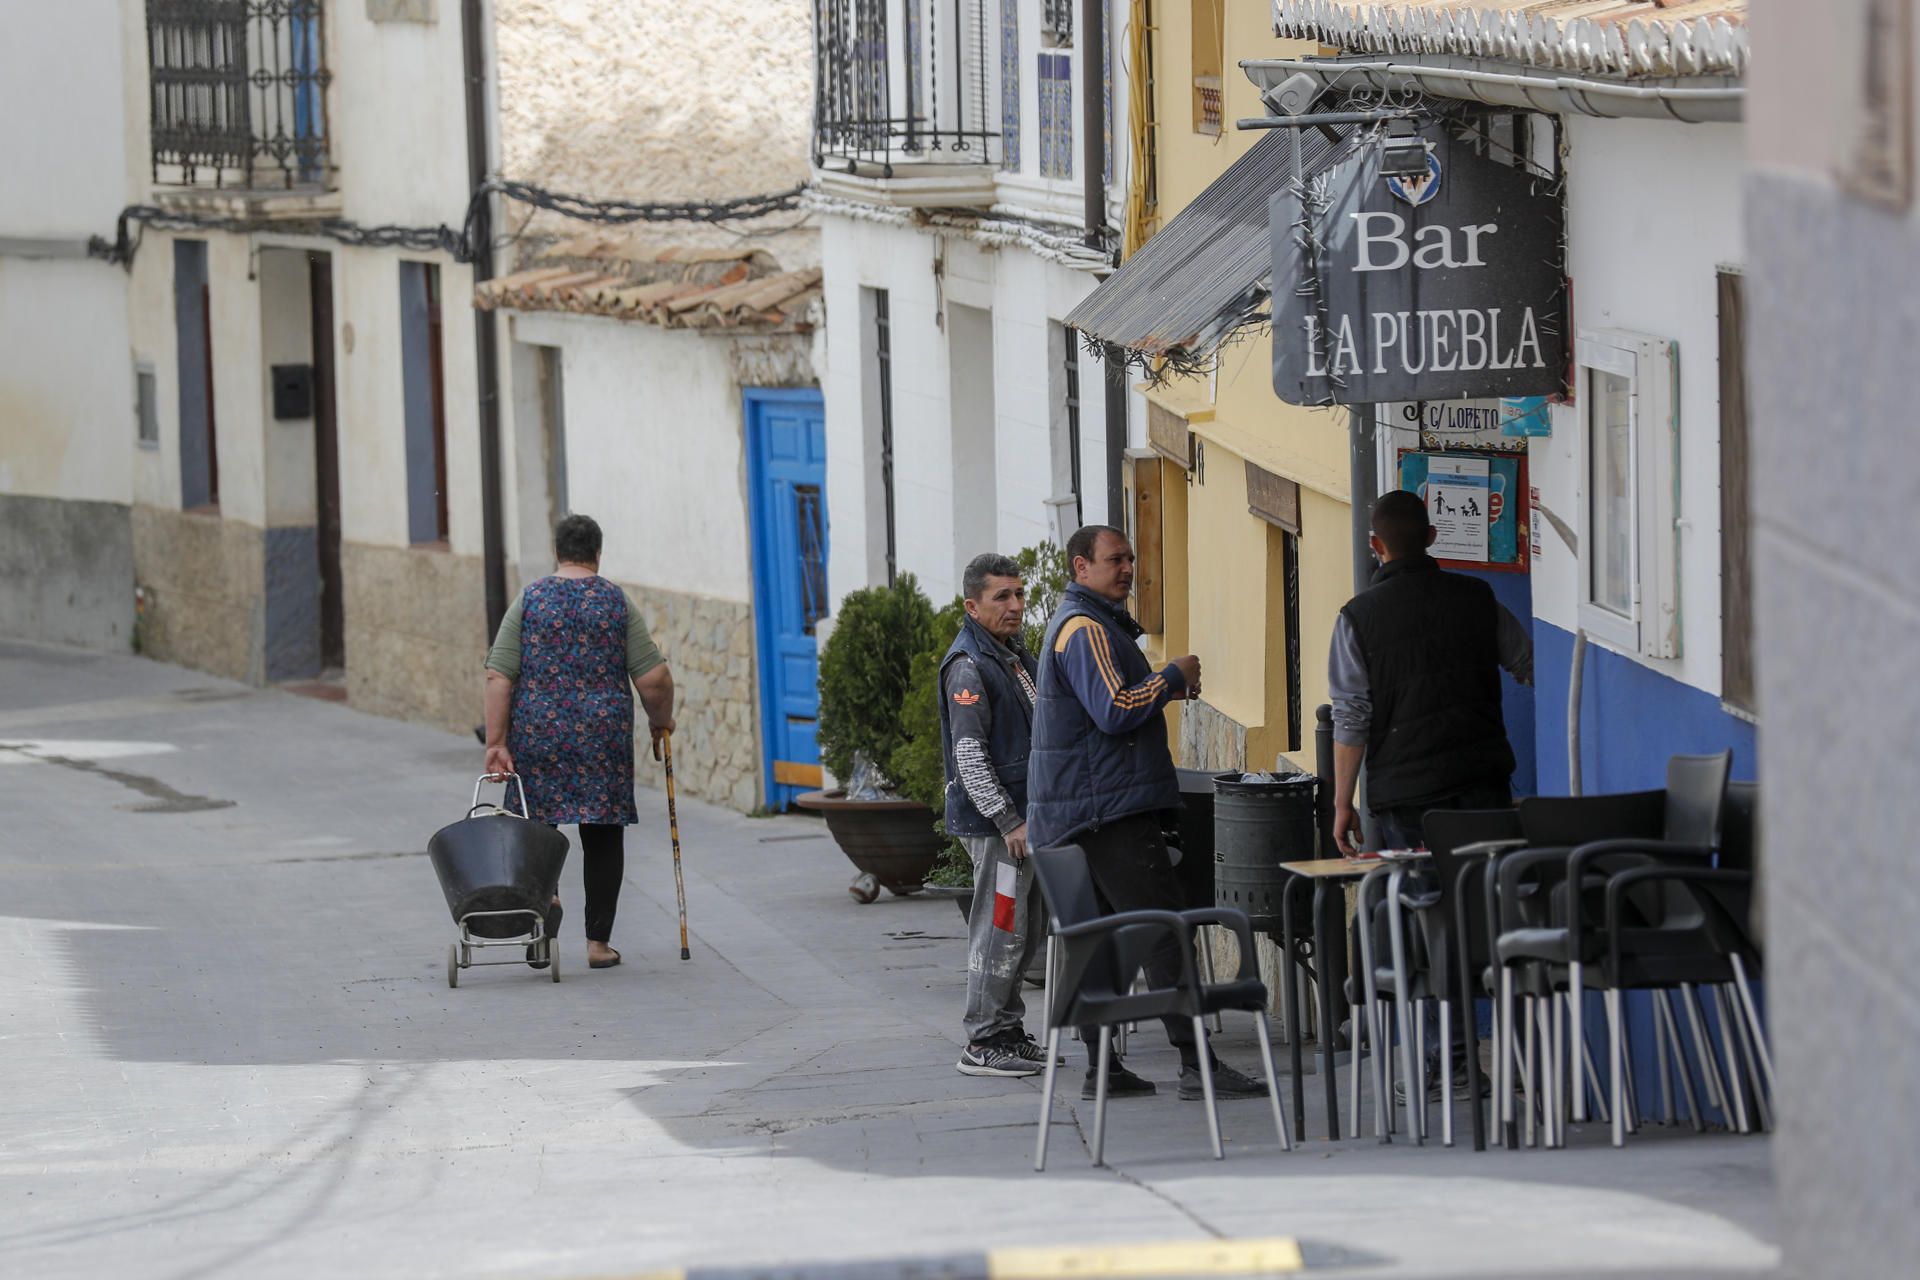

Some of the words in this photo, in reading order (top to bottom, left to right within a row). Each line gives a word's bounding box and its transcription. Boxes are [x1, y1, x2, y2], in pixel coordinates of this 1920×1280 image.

[1351, 211, 1498, 272] Bar
[1304, 313, 1363, 377] LA
[1372, 307, 1546, 375] PUEBLA
[1430, 403, 1445, 429] C/
[1447, 406, 1499, 430] LORETO
